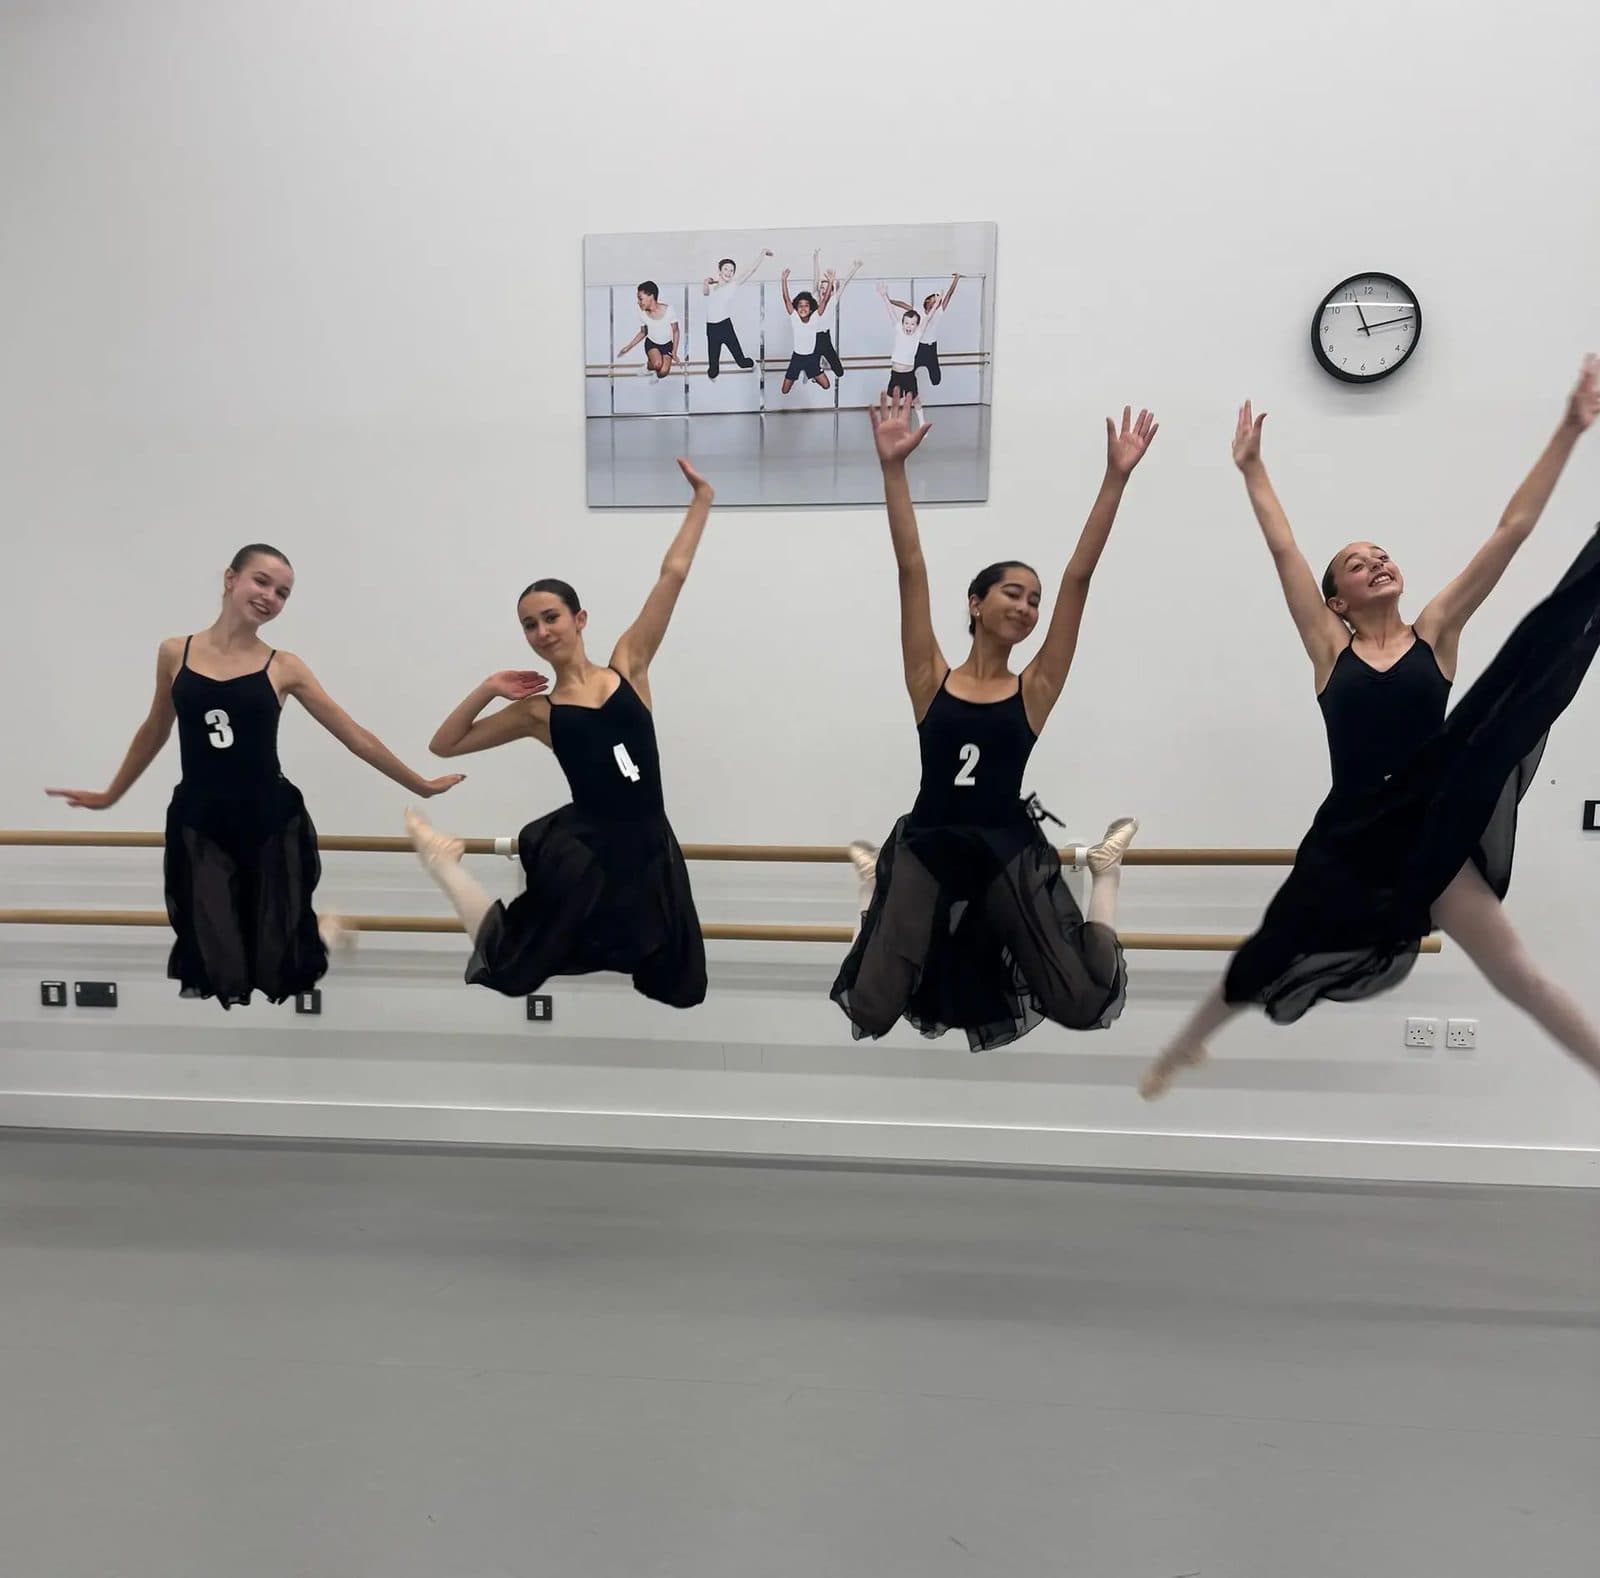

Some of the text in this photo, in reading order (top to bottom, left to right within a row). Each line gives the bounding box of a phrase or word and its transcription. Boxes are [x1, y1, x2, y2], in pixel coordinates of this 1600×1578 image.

[1363, 286, 1374, 295] 12
[1344, 292, 1353, 301] 11
[1331, 306, 1341, 314] 10
[1323, 325, 1329, 333] 9
[1402, 323, 1408, 331] 3
[1328, 344, 1334, 352] 8
[1394, 344, 1400, 352] 4
[1342, 357, 1348, 365] 7
[1379, 357, 1386, 365] 5
[1360, 362, 1366, 371] 6
[205, 709, 234, 748] 3
[613, 742, 640, 782] 4
[954, 743, 980, 786] 2
